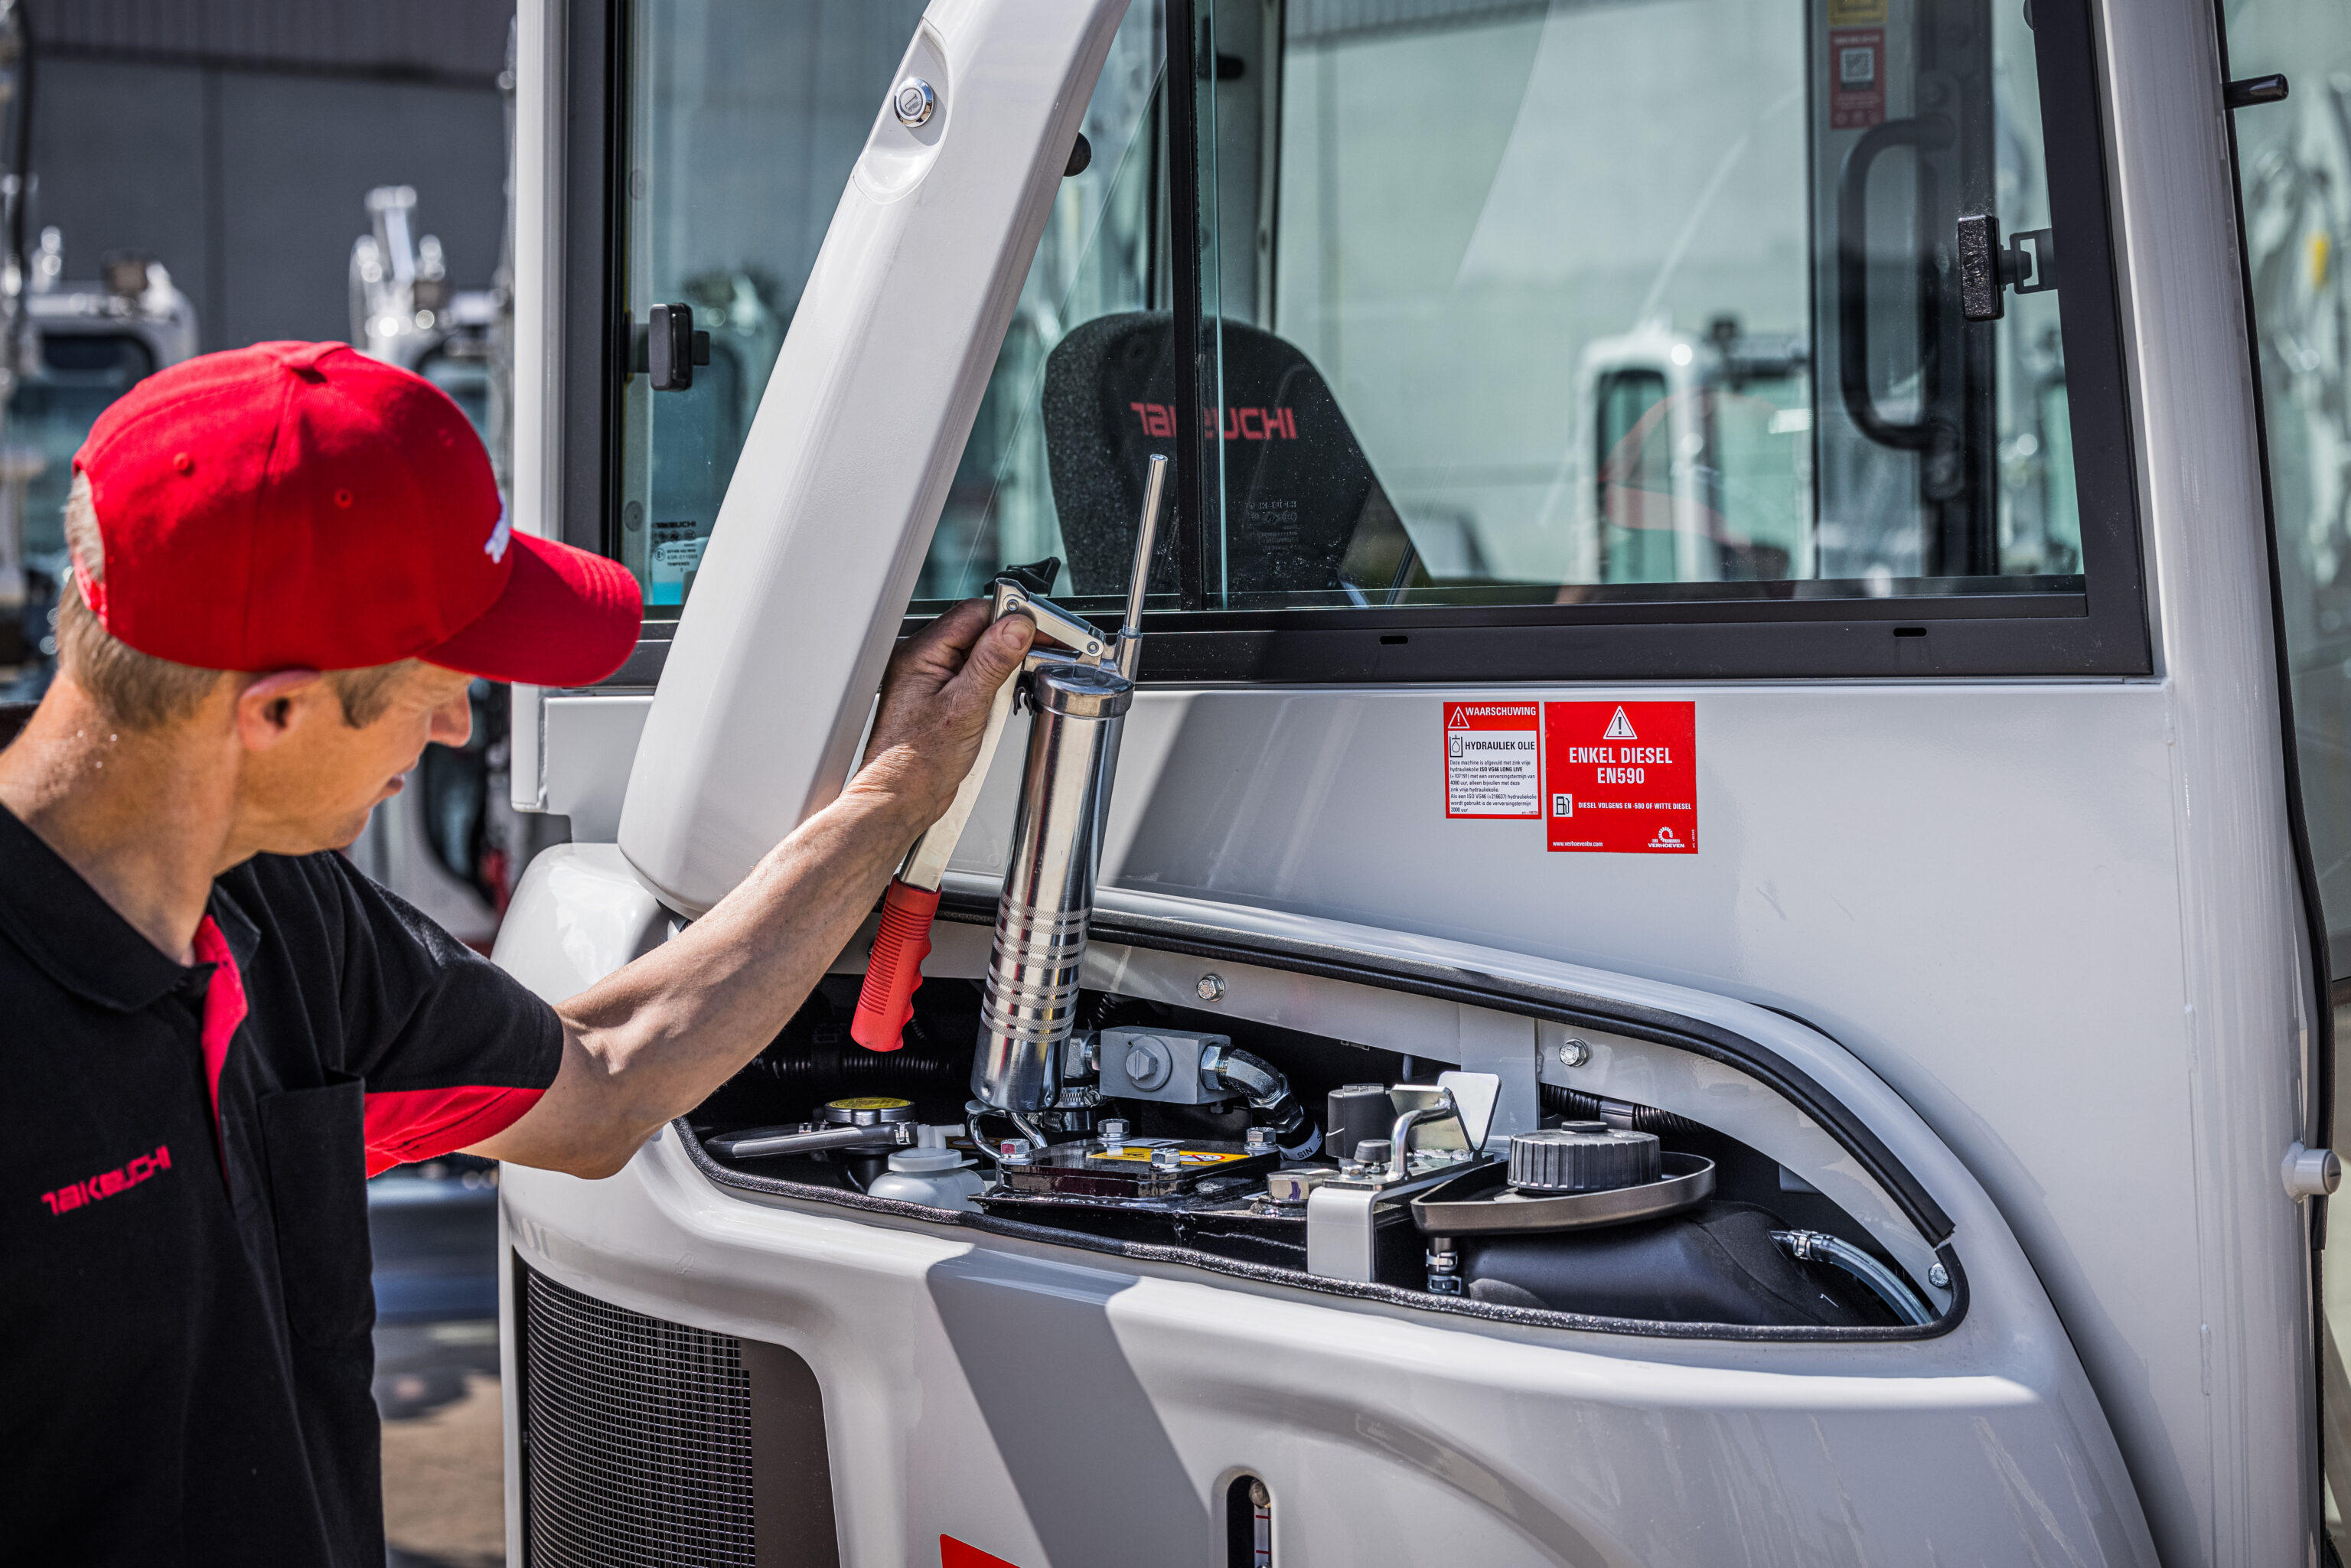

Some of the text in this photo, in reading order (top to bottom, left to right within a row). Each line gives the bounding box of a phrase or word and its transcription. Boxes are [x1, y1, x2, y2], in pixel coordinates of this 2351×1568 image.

[1466, 707, 1536, 716] WAARSCHUWING
[1466, 742, 1535, 750] HYDRAULIEK OLIE
[1570, 748, 1672, 764] ENKEL DIESEL
[1598, 768, 1645, 784] EN590
